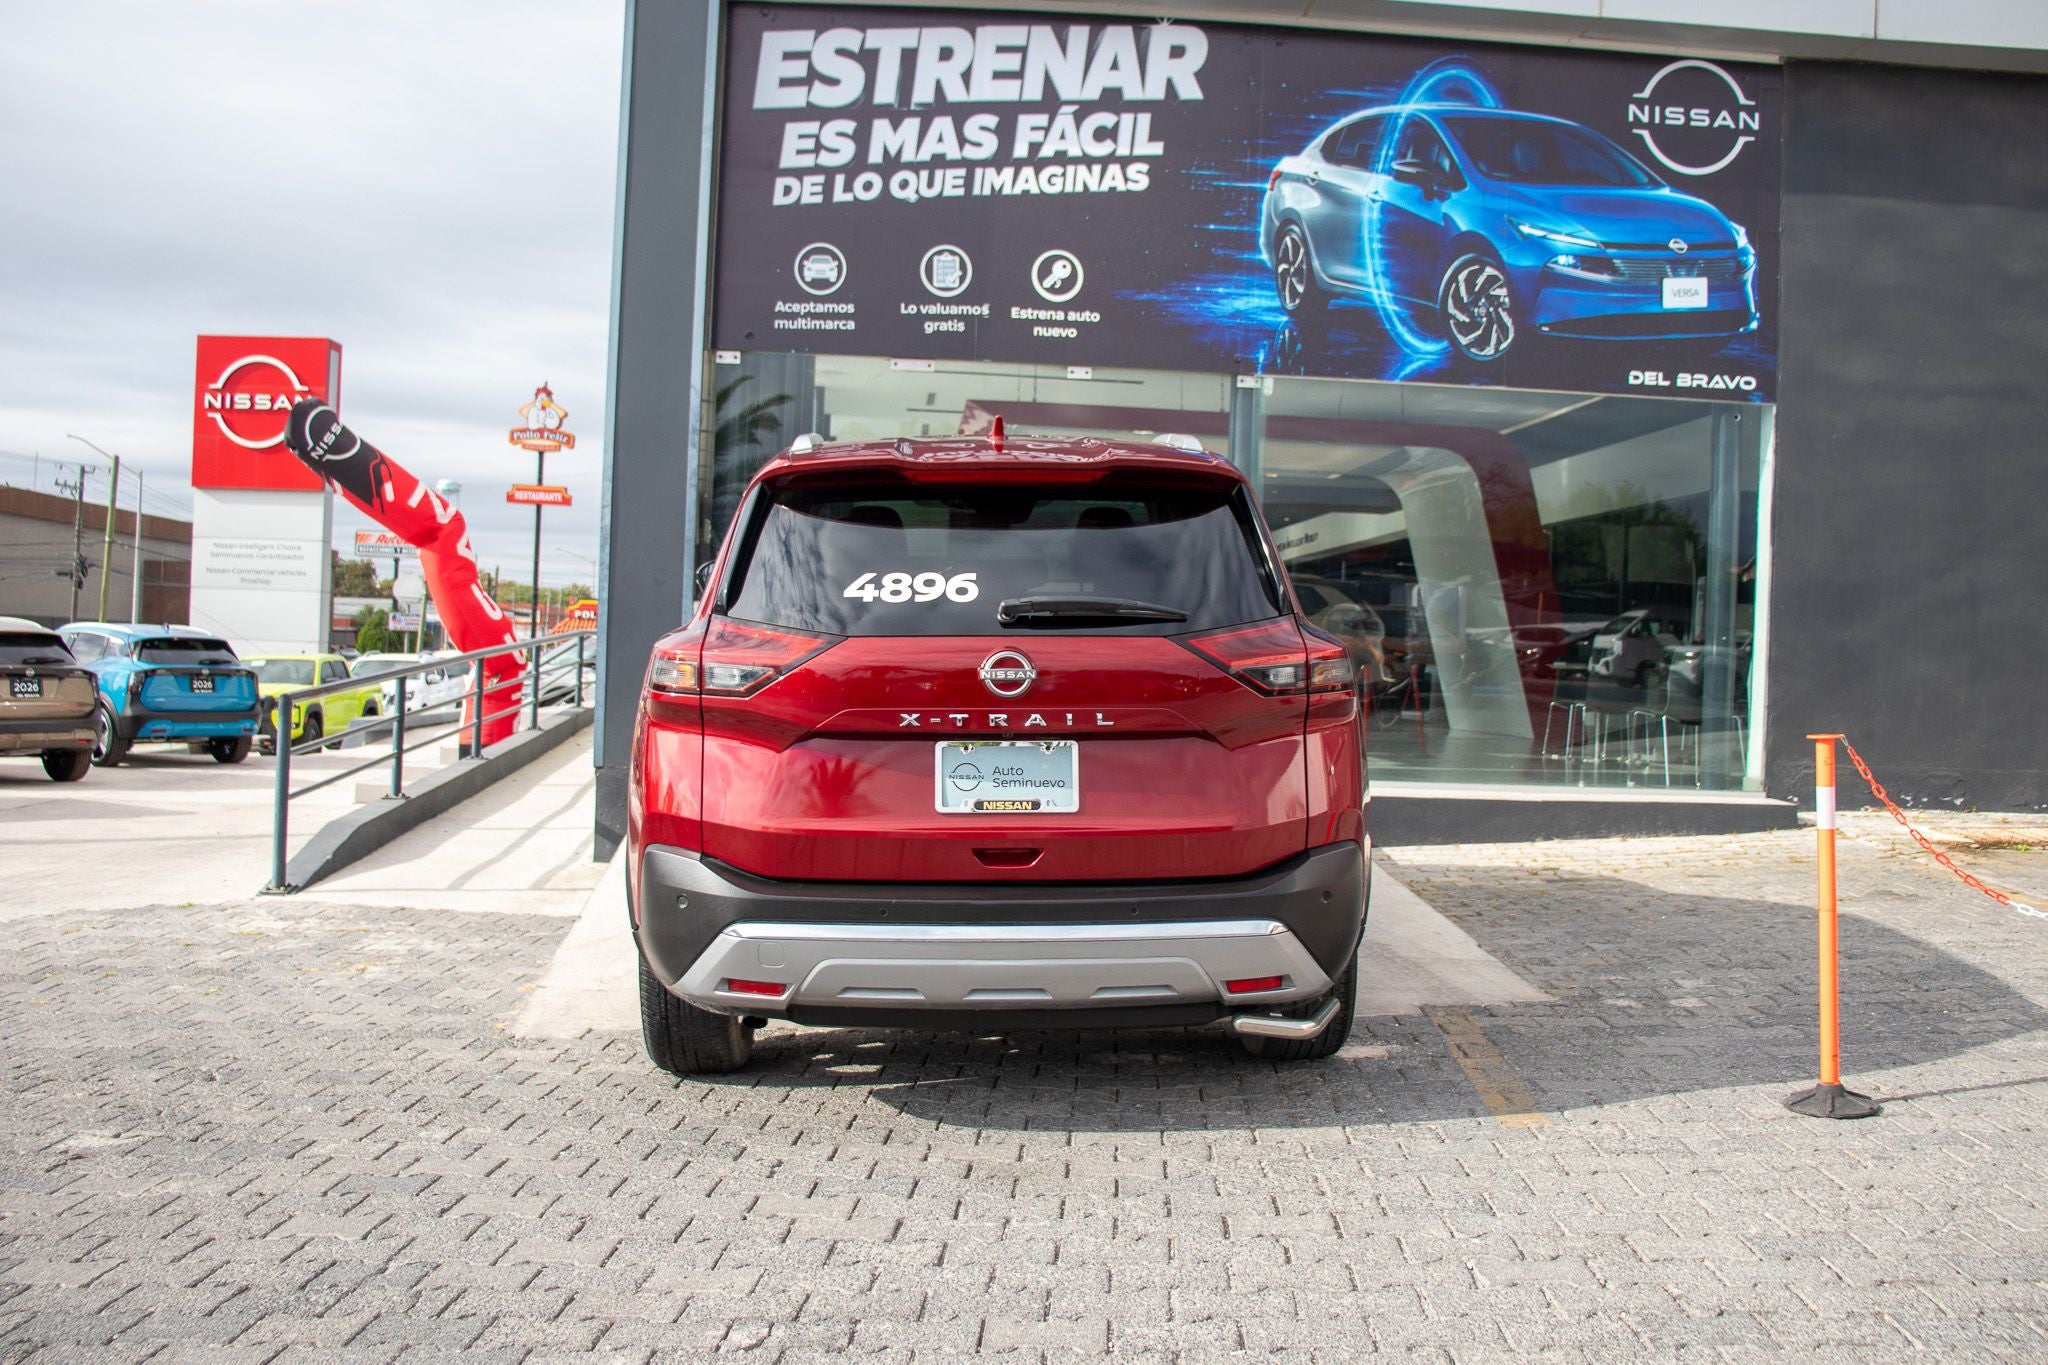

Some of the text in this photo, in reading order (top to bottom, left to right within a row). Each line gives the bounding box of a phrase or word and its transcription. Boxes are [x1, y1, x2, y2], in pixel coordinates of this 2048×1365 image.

[752, 24, 1209, 110] ESTRENAR
[1628, 103, 1759, 131] NISSAN
[779, 105, 1165, 169] ES MAS FÁCIL
[772, 163, 1151, 206] DE LO QUE IMAGINAS
[1671, 288, 1700, 297] VERSA
[775, 301, 855, 318] Aceptamos
[900, 302, 990, 318] Lo valuamos
[1011, 307, 1100, 323] Estrena auto
[774, 317, 856, 332] multimarca
[924, 318, 966, 334] gratis
[1033, 327, 1078, 340] nuevo
[1628, 370, 1757, 391] DEL BRAVO
[310, 422, 343, 460] NISS
[513, 430, 569, 443] Pollo Feliz
[514, 490, 563, 502] RESTAURANTE
[376, 534, 404, 544] Auto
[843, 572, 979, 603] 4896
[980, 670, 1037, 680] NISSAN
[13, 682, 39, 692] 2026
[192, 680, 213, 688] 2026
[899, 713, 1115, 727] X-TRAIL
[992, 766, 1024, 776] Auto
[992, 778, 1066, 788] Seminuevo
[983, 801, 1032, 810] NISSAN
